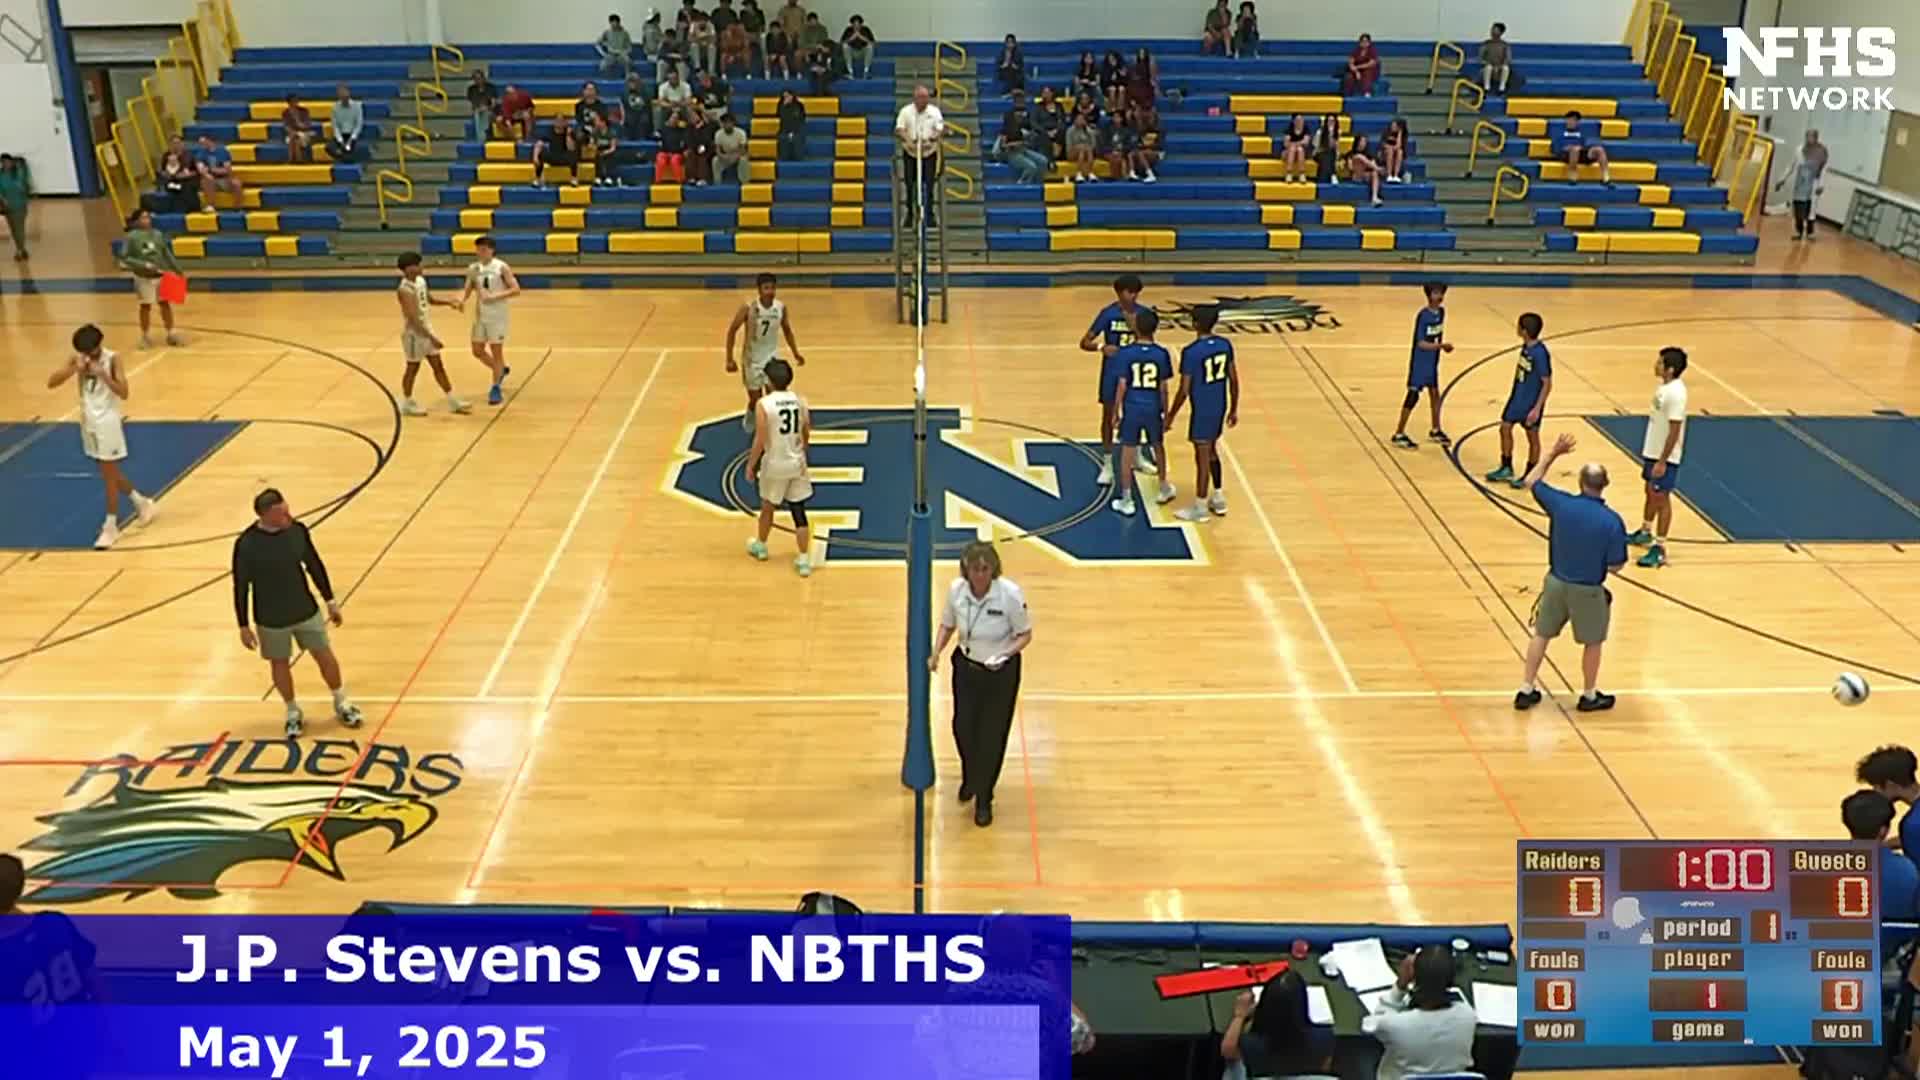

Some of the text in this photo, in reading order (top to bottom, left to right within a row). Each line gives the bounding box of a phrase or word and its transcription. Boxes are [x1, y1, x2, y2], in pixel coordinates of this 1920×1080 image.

[761, 320, 770, 336] 7
[1131, 362, 1158, 388] 12
[1204, 354, 1228, 384] 17
[778, 408, 799, 435] 31
[64, 738, 465, 797] RAIDERS
